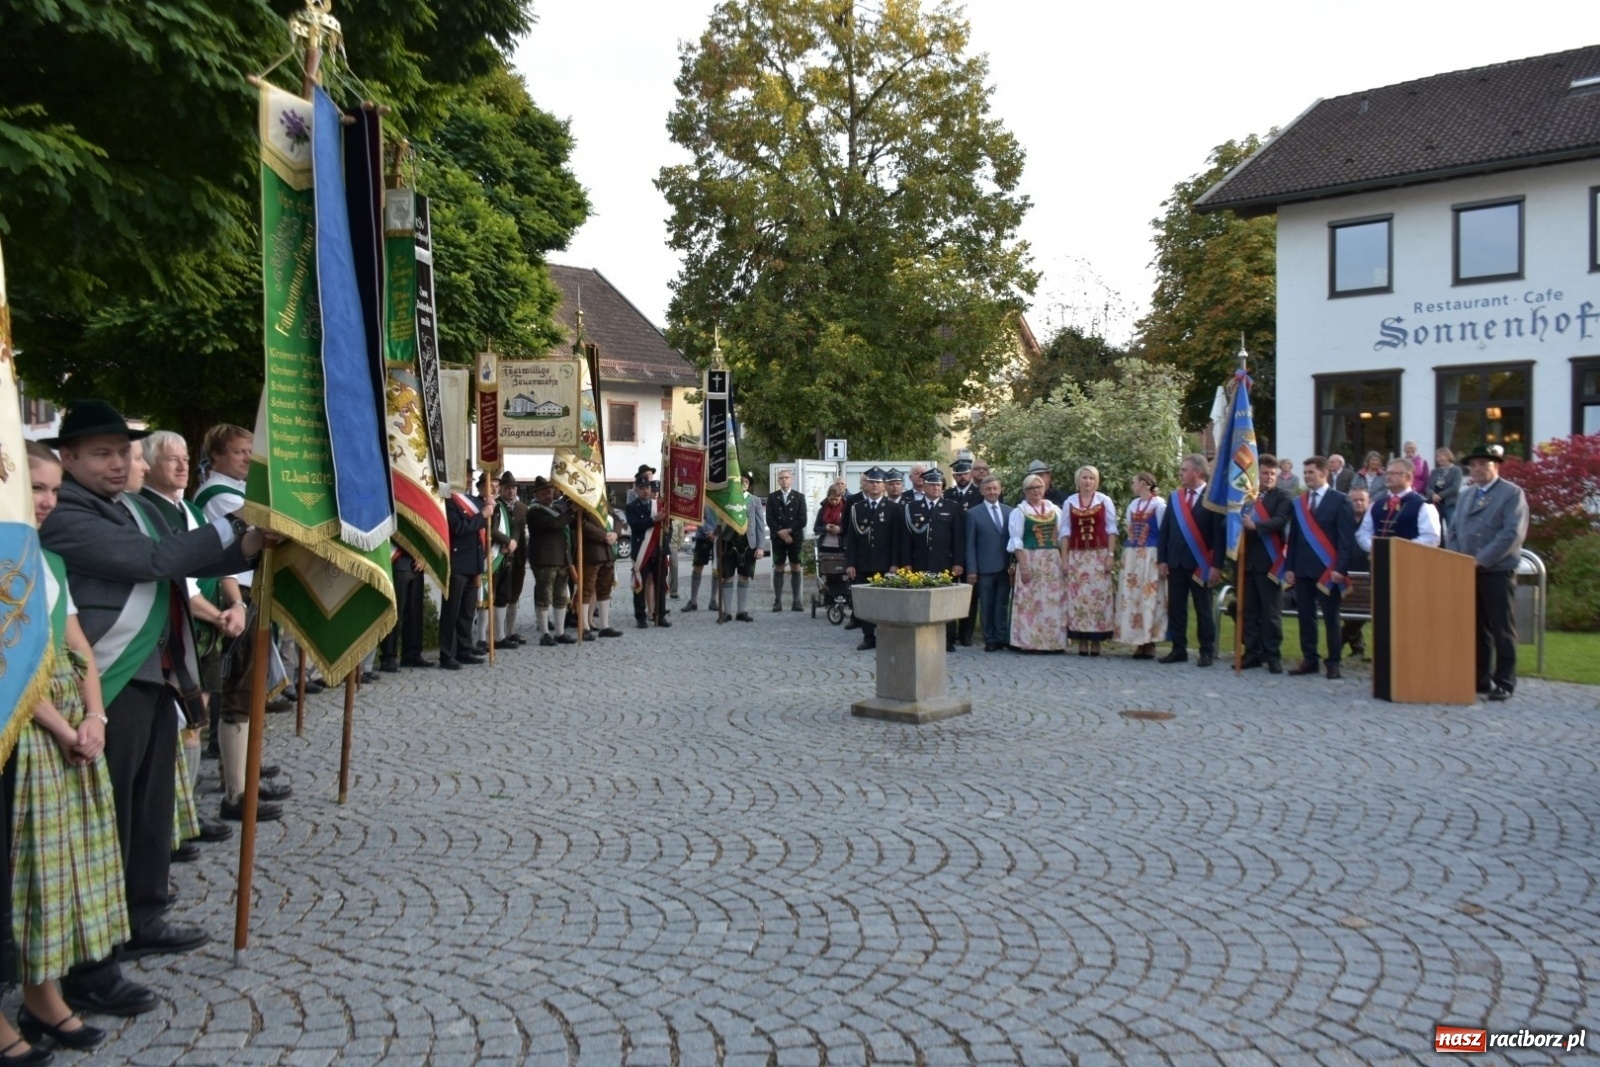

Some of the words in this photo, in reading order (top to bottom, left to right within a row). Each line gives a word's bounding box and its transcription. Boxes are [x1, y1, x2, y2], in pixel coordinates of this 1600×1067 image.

[1413, 294, 1509, 314] Restaurant
[1523, 288, 1564, 304] Cafe
[1373, 300, 1600, 351] Sonnenhof
[501, 364, 550, 378] Freiwillige
[511, 375, 559, 387] Feuerwehr
[500, 425, 556, 439] Magnetsried
[311, 472, 333, 485] 2012
